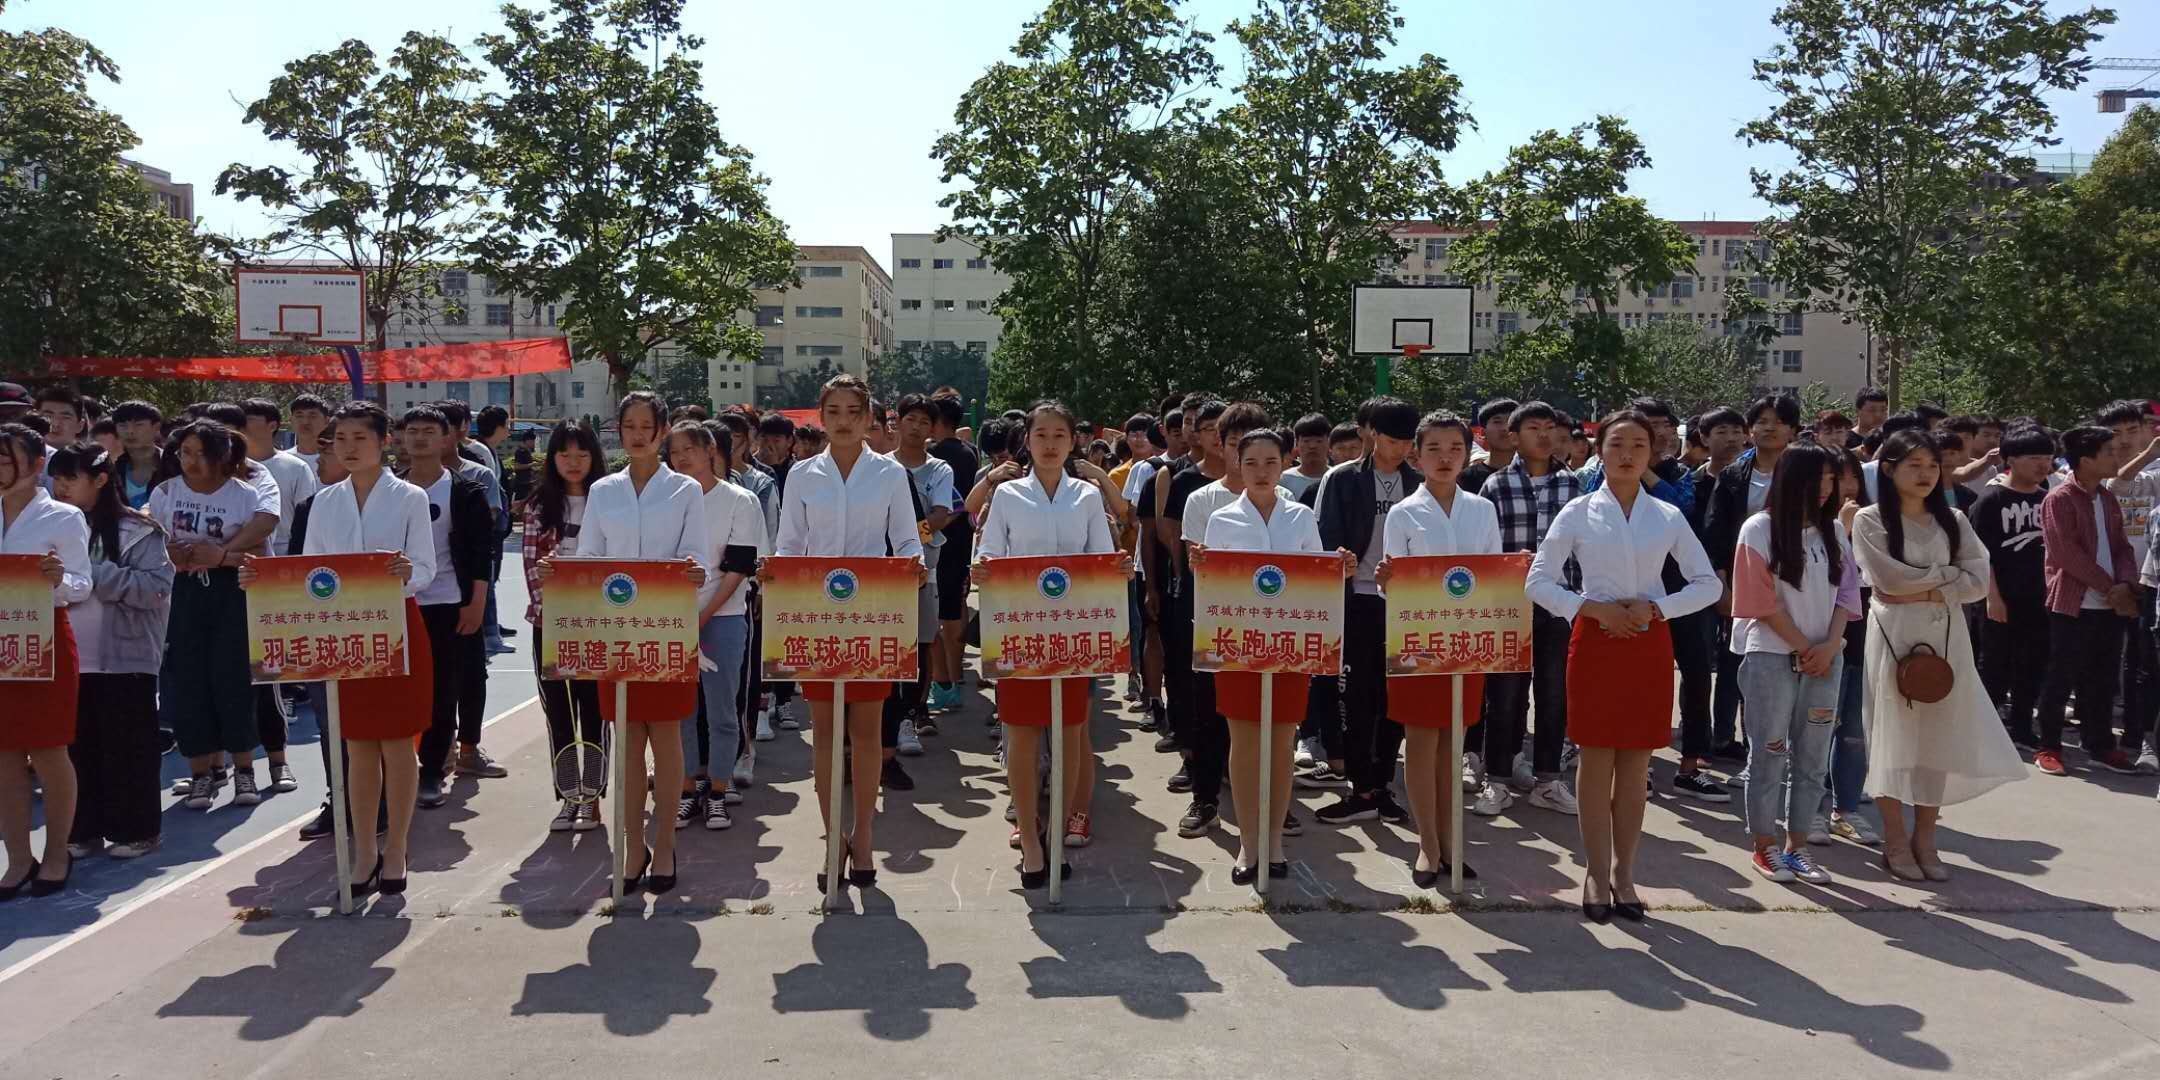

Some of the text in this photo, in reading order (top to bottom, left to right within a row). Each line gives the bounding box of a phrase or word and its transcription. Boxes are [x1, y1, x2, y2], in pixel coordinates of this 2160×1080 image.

[259, 609, 390, 625] 项城市中等专业学校
[555, 616, 685, 629] 项城市中等专业学校
[776, 612, 905, 624] 项城市中等专业学校
[993, 607, 1116, 624] 项城市中等专业学校
[1206, 604, 1329, 621] 项城市中等专业学校
[1399, 607, 1519, 621] 项城市中等专业学校
[0, 634, 41, 665] 项目
[263, 633, 389, 668] 羽毛球项目
[558, 640, 684, 671] 踢毽子项目
[783, 635, 898, 667] 篮球项目
[1000, 631, 1113, 665] 托球跑项目
[1211, 626, 1323, 662] 长跑项目
[1400, 630, 1518, 661] 乒乓球项目
